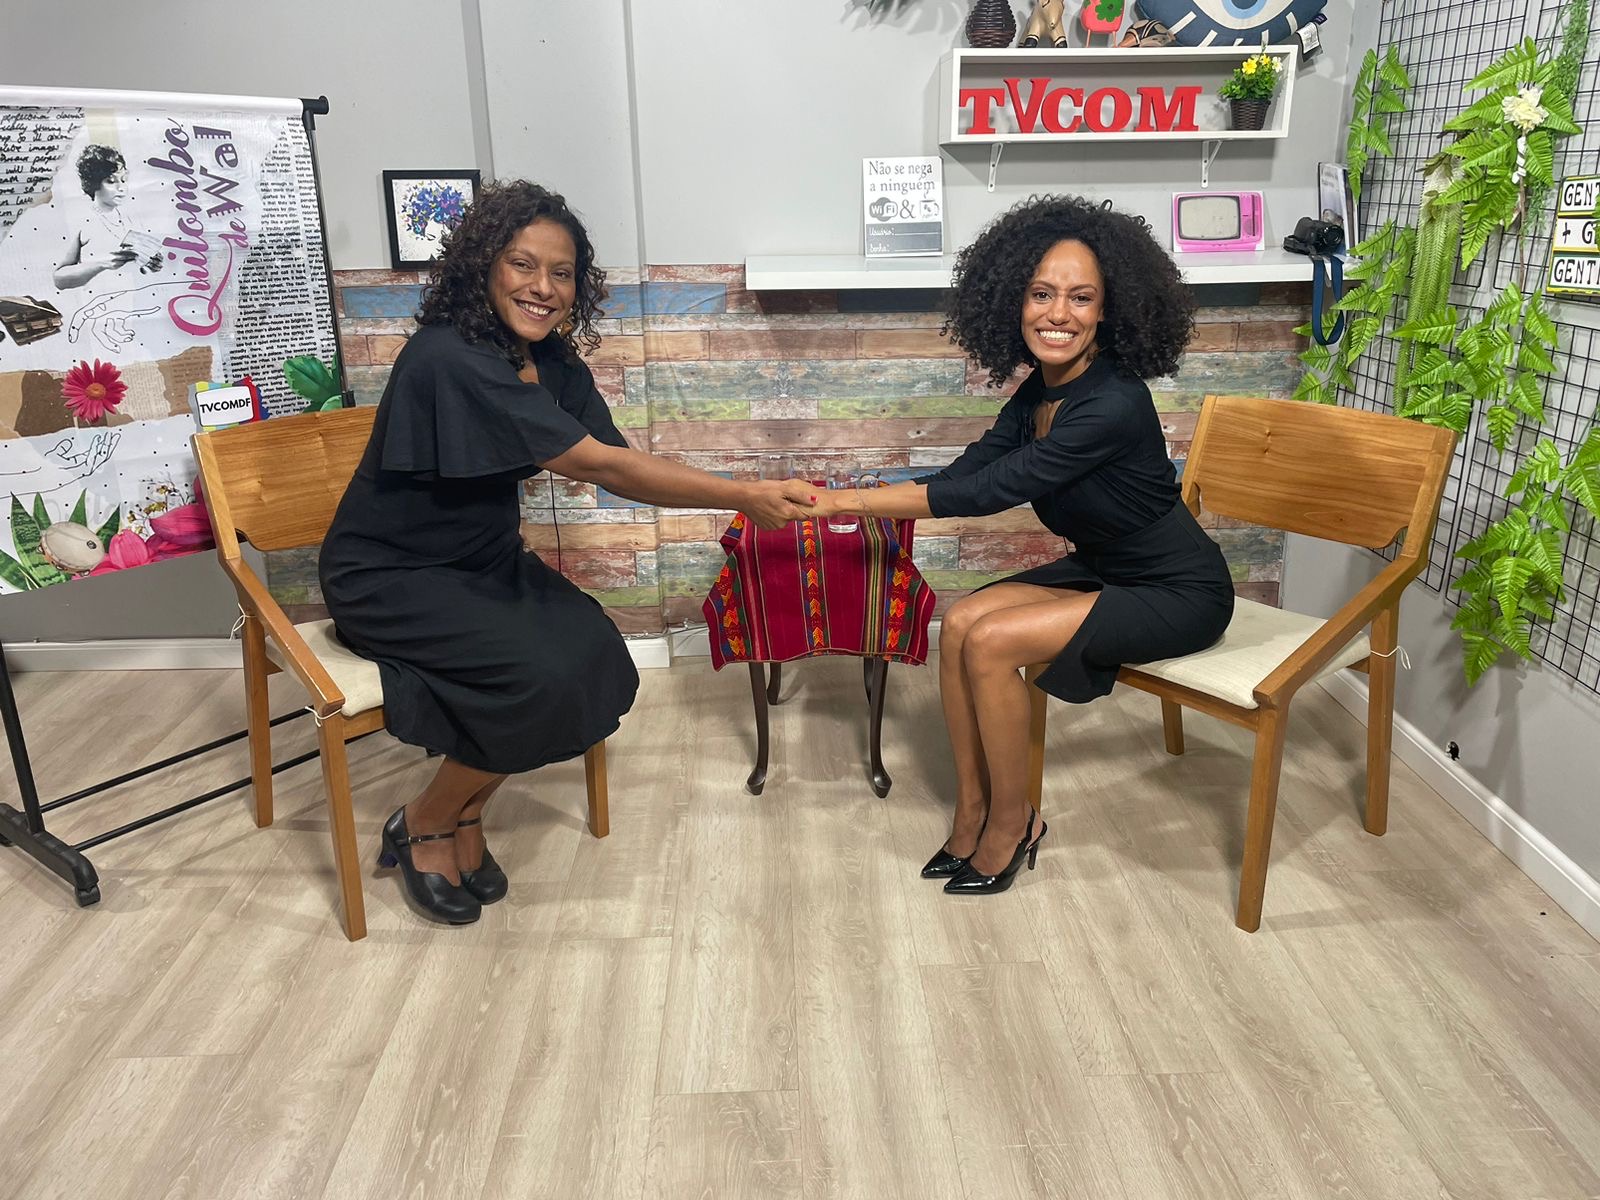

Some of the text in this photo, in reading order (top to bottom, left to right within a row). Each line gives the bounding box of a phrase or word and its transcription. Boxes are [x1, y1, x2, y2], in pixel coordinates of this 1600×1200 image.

[959, 77, 1203, 134] TVCOM
[869, 161, 891, 175] Não
[908, 163, 932, 179] nega
[880, 179, 935, 195] ninguém
[900, 199, 916, 219] &
[148, 118, 223, 336] Quilombo
[218, 217, 249, 248] de
[1582, 221, 1600, 245] G
[1553, 258, 1600, 286] GENT
[200, 398, 251, 413] TVCOMDF
